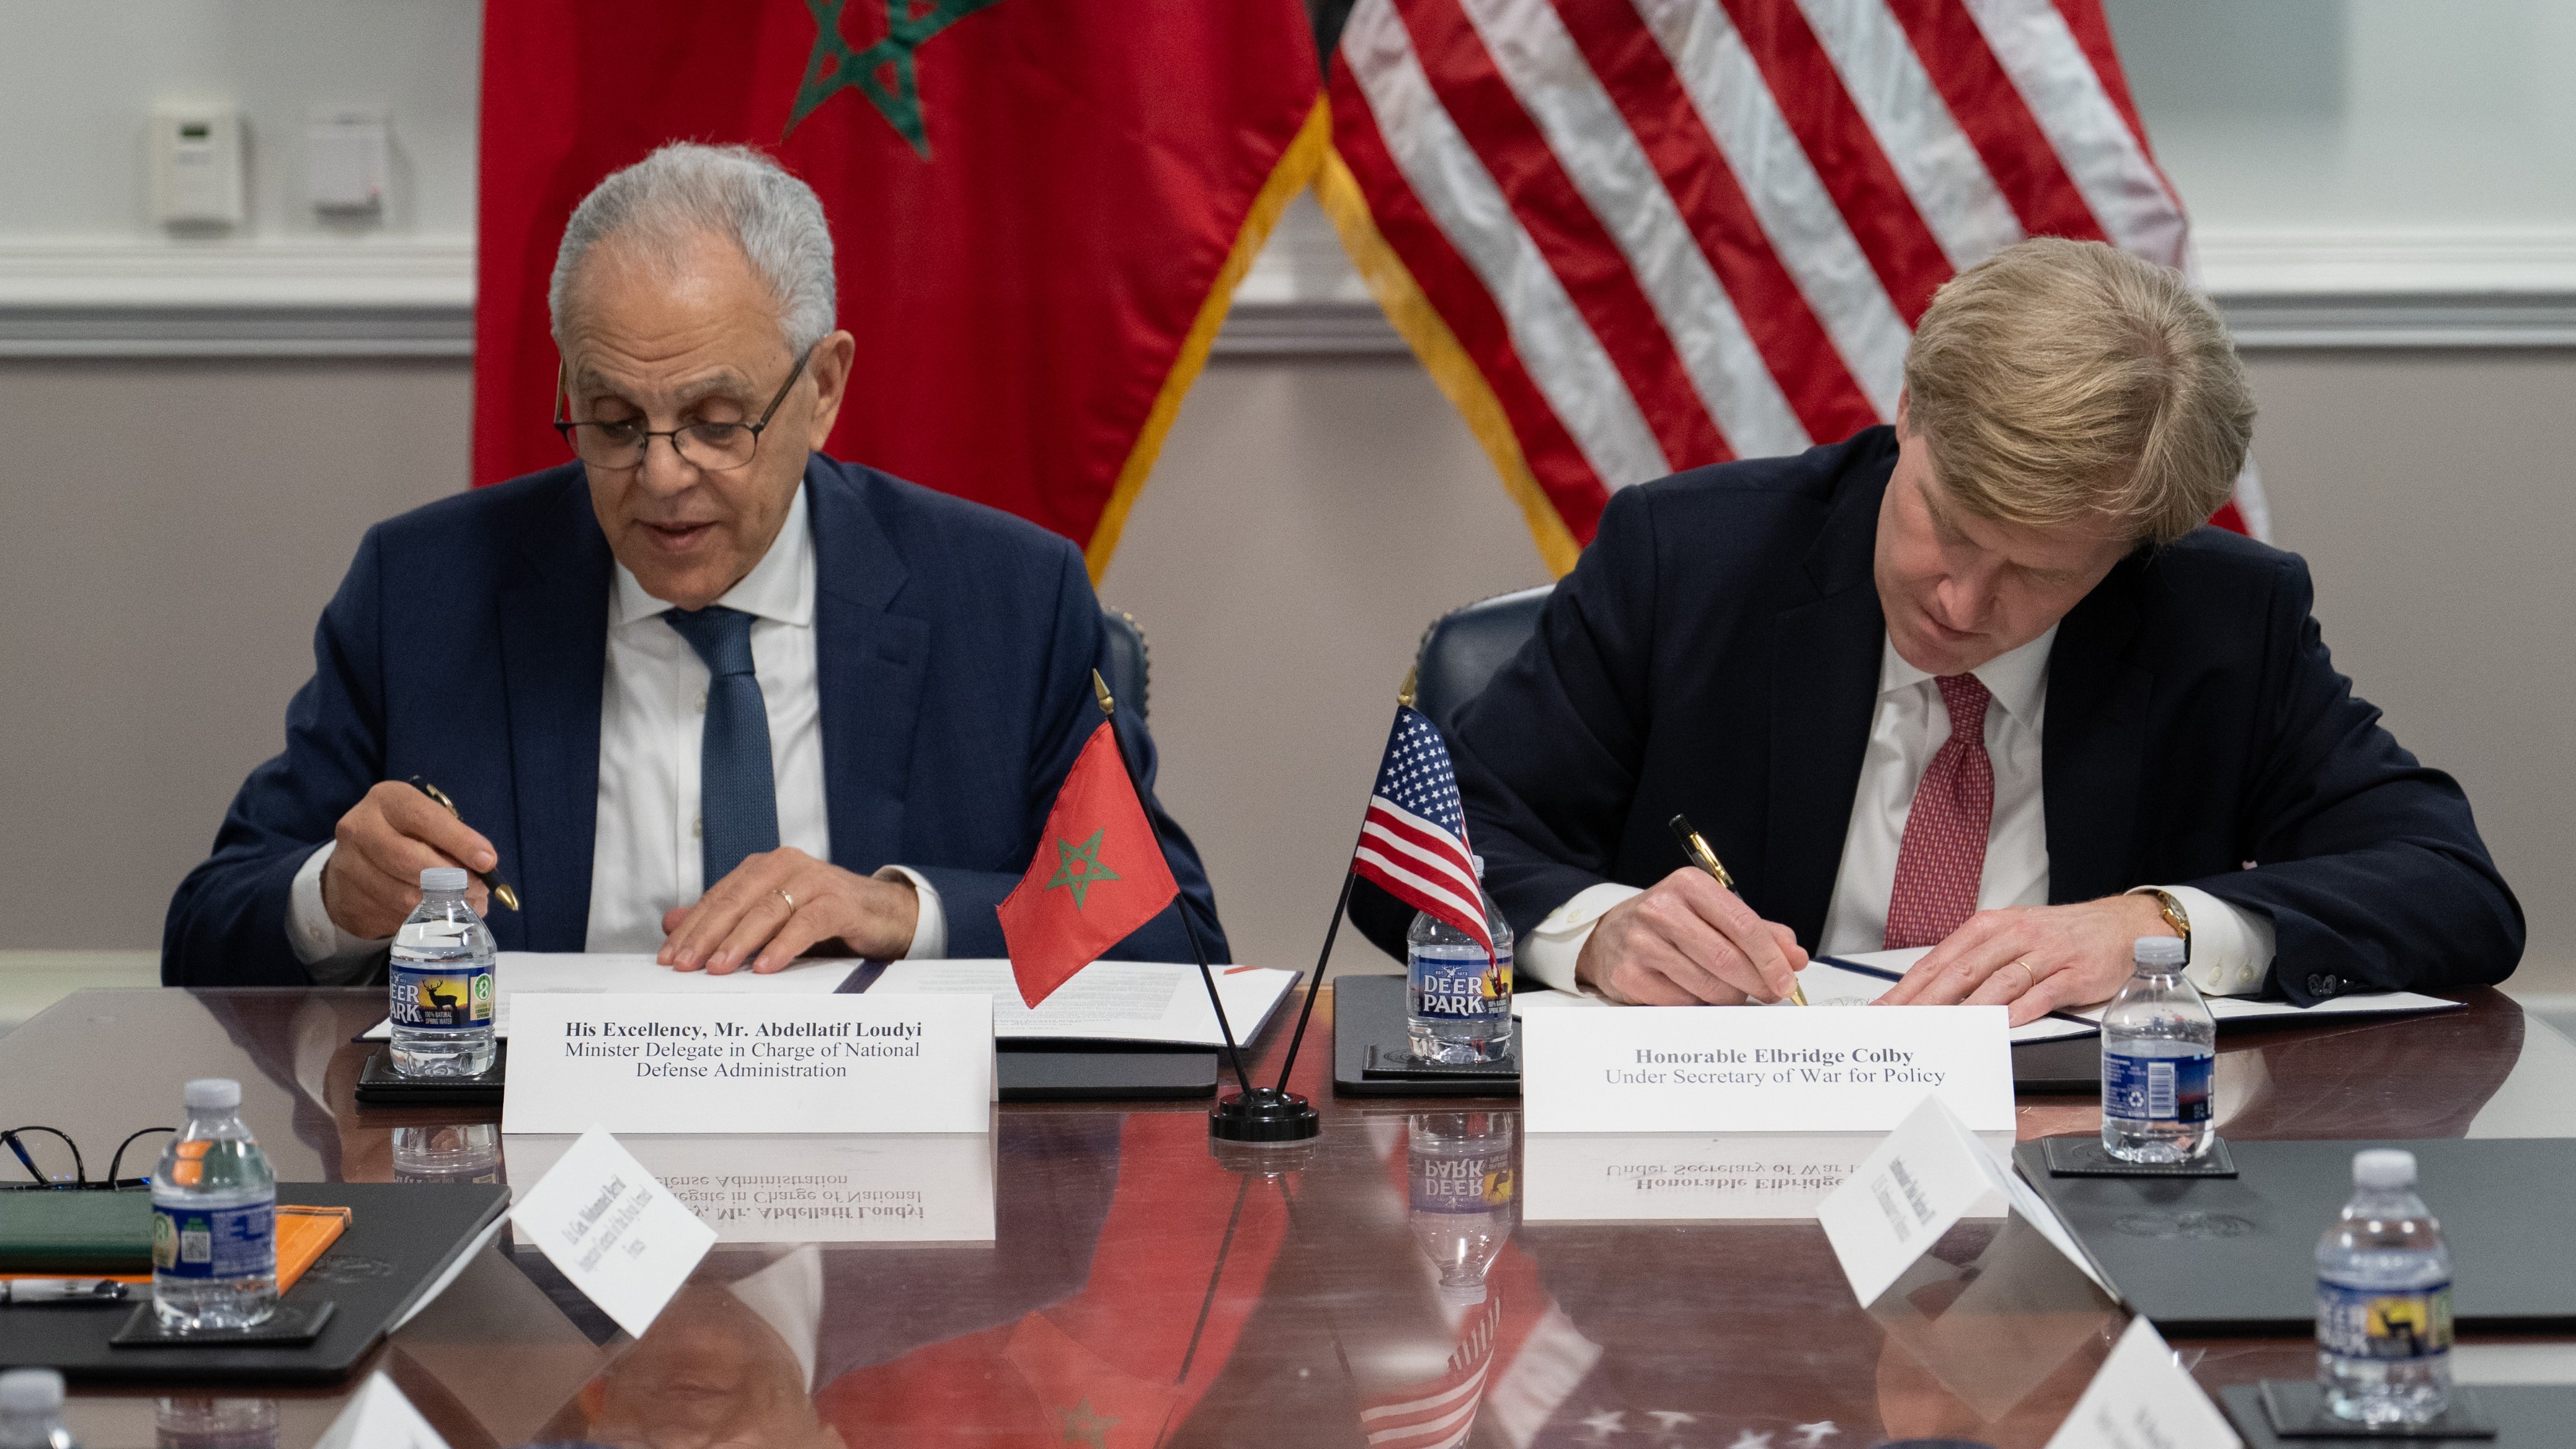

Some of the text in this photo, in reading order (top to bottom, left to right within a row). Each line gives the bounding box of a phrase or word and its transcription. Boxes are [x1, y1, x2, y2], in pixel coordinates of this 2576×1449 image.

[391, 982, 420, 1003] EER
[1424, 975, 1484, 995] DEER
[390, 1000, 421, 1024] ARK
[1424, 994, 1484, 1017] PARK
[565, 1022, 922, 1041] His Excellency, Mr. Abdellatif Loudyi
[565, 1041, 919, 1061] Minister Delegate in Charge of National
[1635, 1048, 1914, 1067] Honorable Elbridge Colby
[636, 1062, 847, 1077] Defense Administration
[1606, 1067, 1946, 1087] Under Secretary of War for Policy
